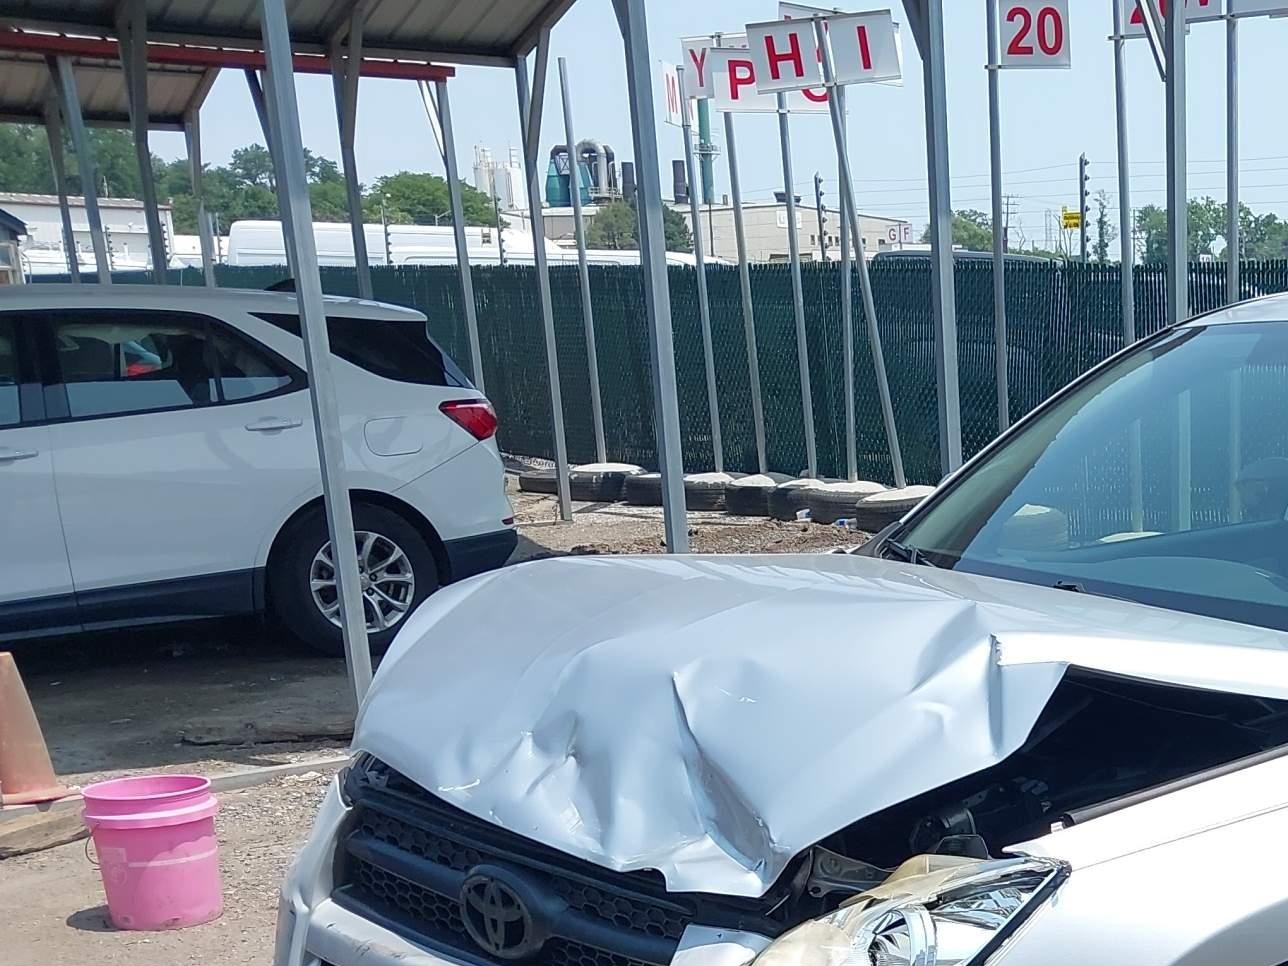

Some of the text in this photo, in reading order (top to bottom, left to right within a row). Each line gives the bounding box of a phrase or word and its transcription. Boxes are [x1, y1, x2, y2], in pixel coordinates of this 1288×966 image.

[1006, 6, 1063, 56] 20
[689, 47, 707, 87] Y
[764, 32, 804, 80] H
[728, 59, 755, 100] P
[888, 228, 897, 241] G
[903, 227, 910, 240] F
